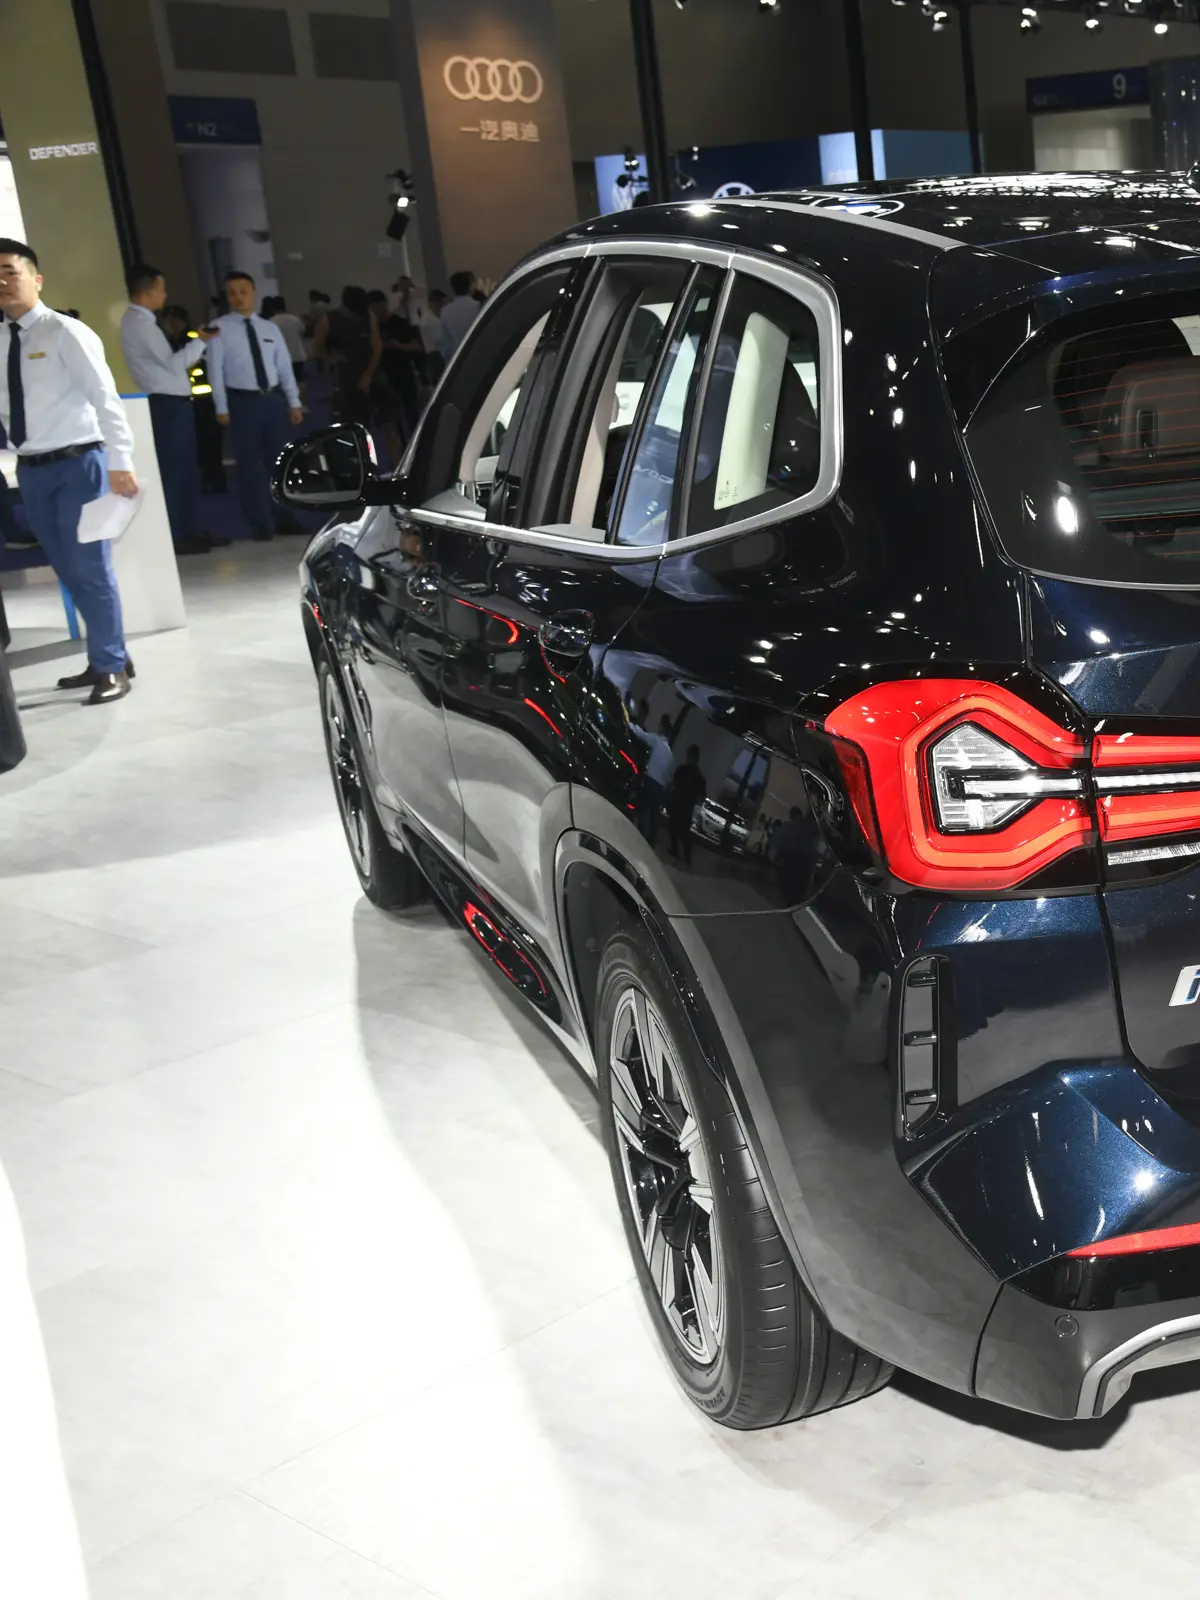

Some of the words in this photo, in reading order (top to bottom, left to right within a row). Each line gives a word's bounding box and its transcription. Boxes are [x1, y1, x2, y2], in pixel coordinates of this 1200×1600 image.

[1112, 73, 1127, 99] 9
[460, 119, 541, 142] 一汽奥迪
[29, 142, 98, 160] DEFENDER
